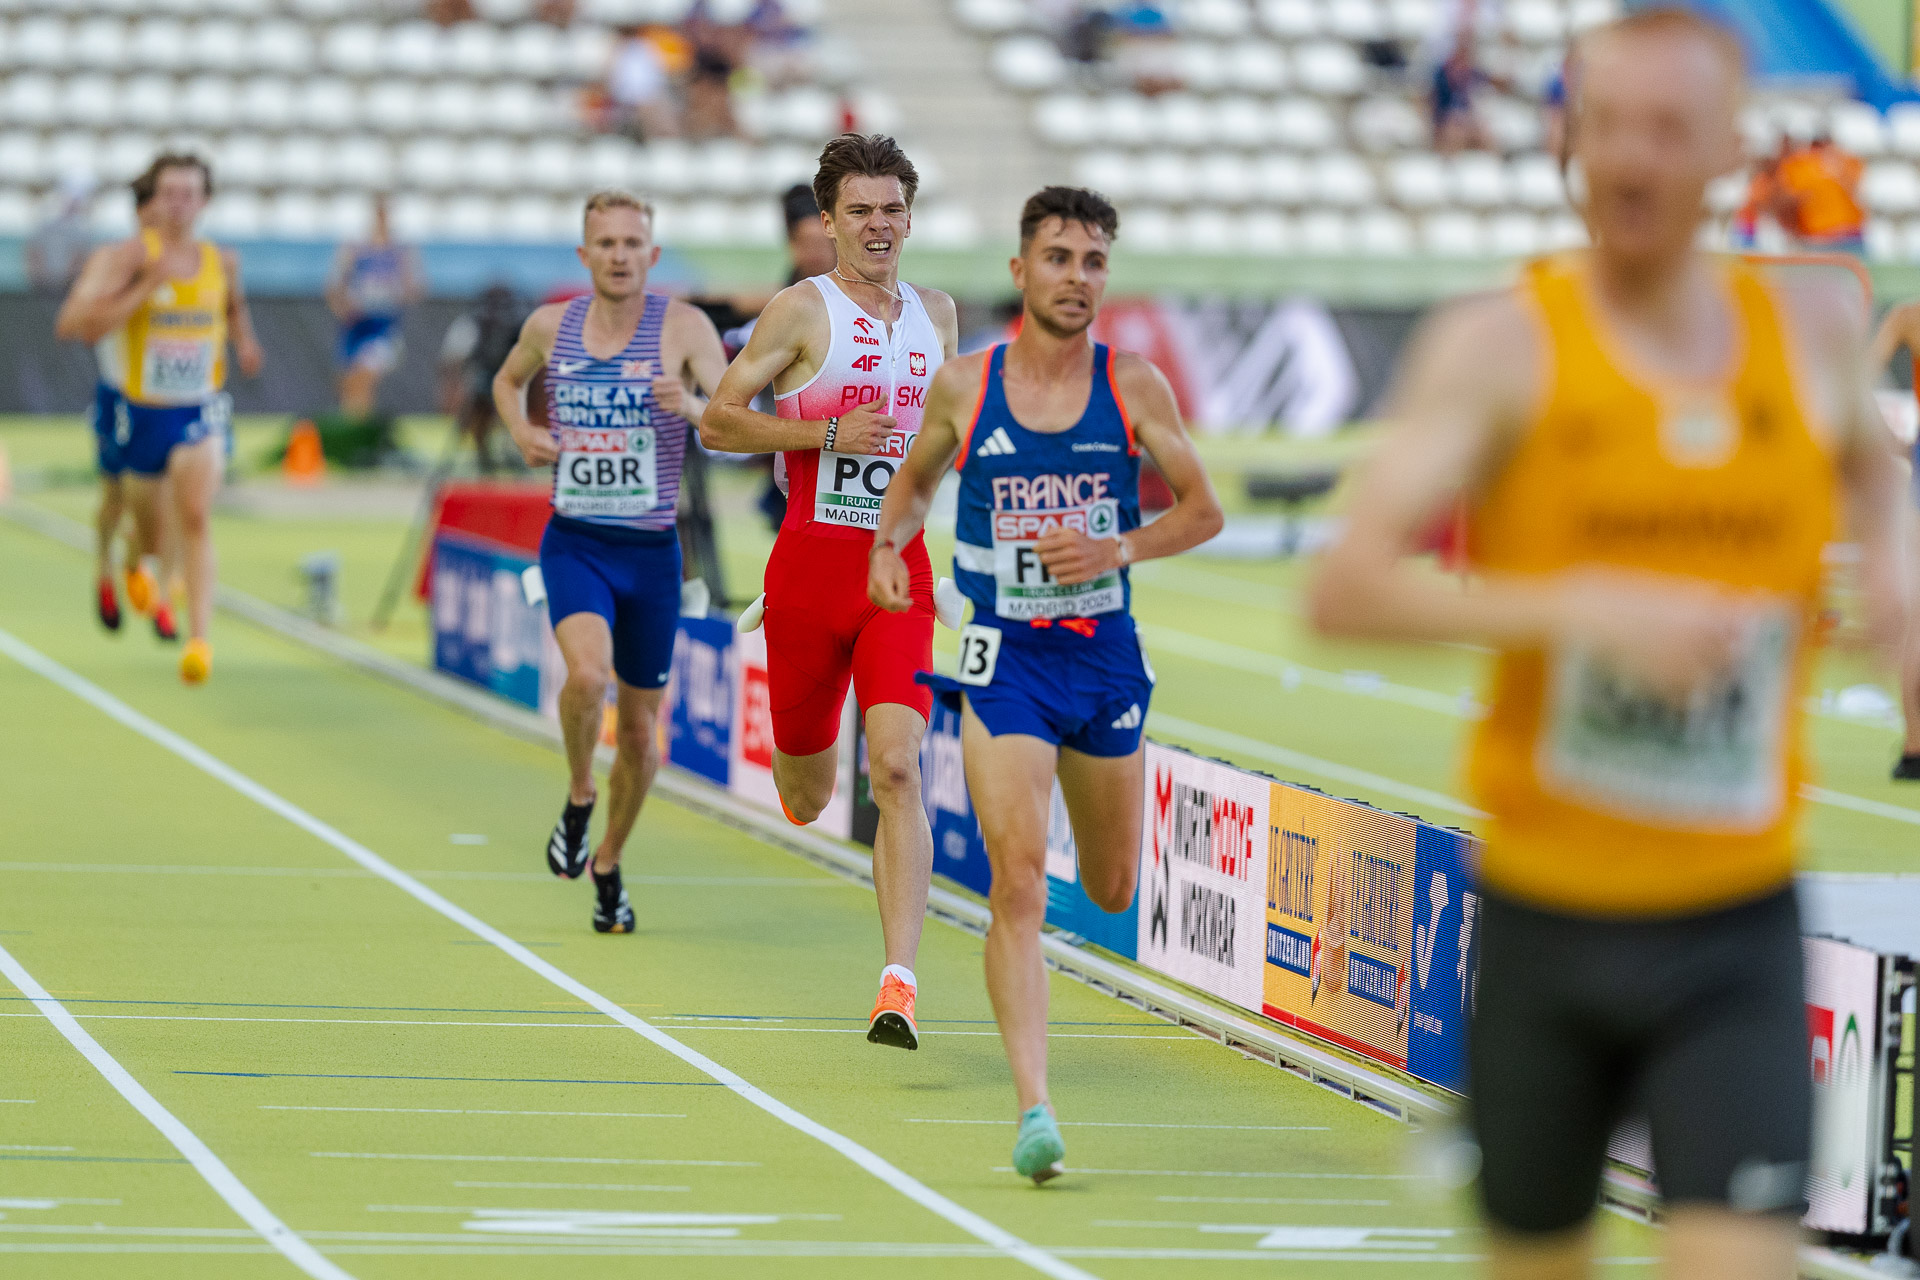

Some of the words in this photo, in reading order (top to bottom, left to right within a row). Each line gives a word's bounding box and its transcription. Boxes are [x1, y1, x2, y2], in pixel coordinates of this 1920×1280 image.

[853, 335, 880, 346] ORLEN
[851, 354, 883, 372] 4F
[554, 385, 650, 407] GREAT
[556, 406, 651, 427] BRITAIN
[571, 457, 642, 486] GBR
[832, 456, 898, 497] PO
[845, 496, 870, 508] RUN
[991, 473, 1111, 511] FRANCE
[1008, 599, 1077, 616] MADRID
[960, 636, 989, 676] 13
[1181, 879, 1236, 969] WORKWEAR
[1267, 928, 1311, 971] SWITZERLAND
